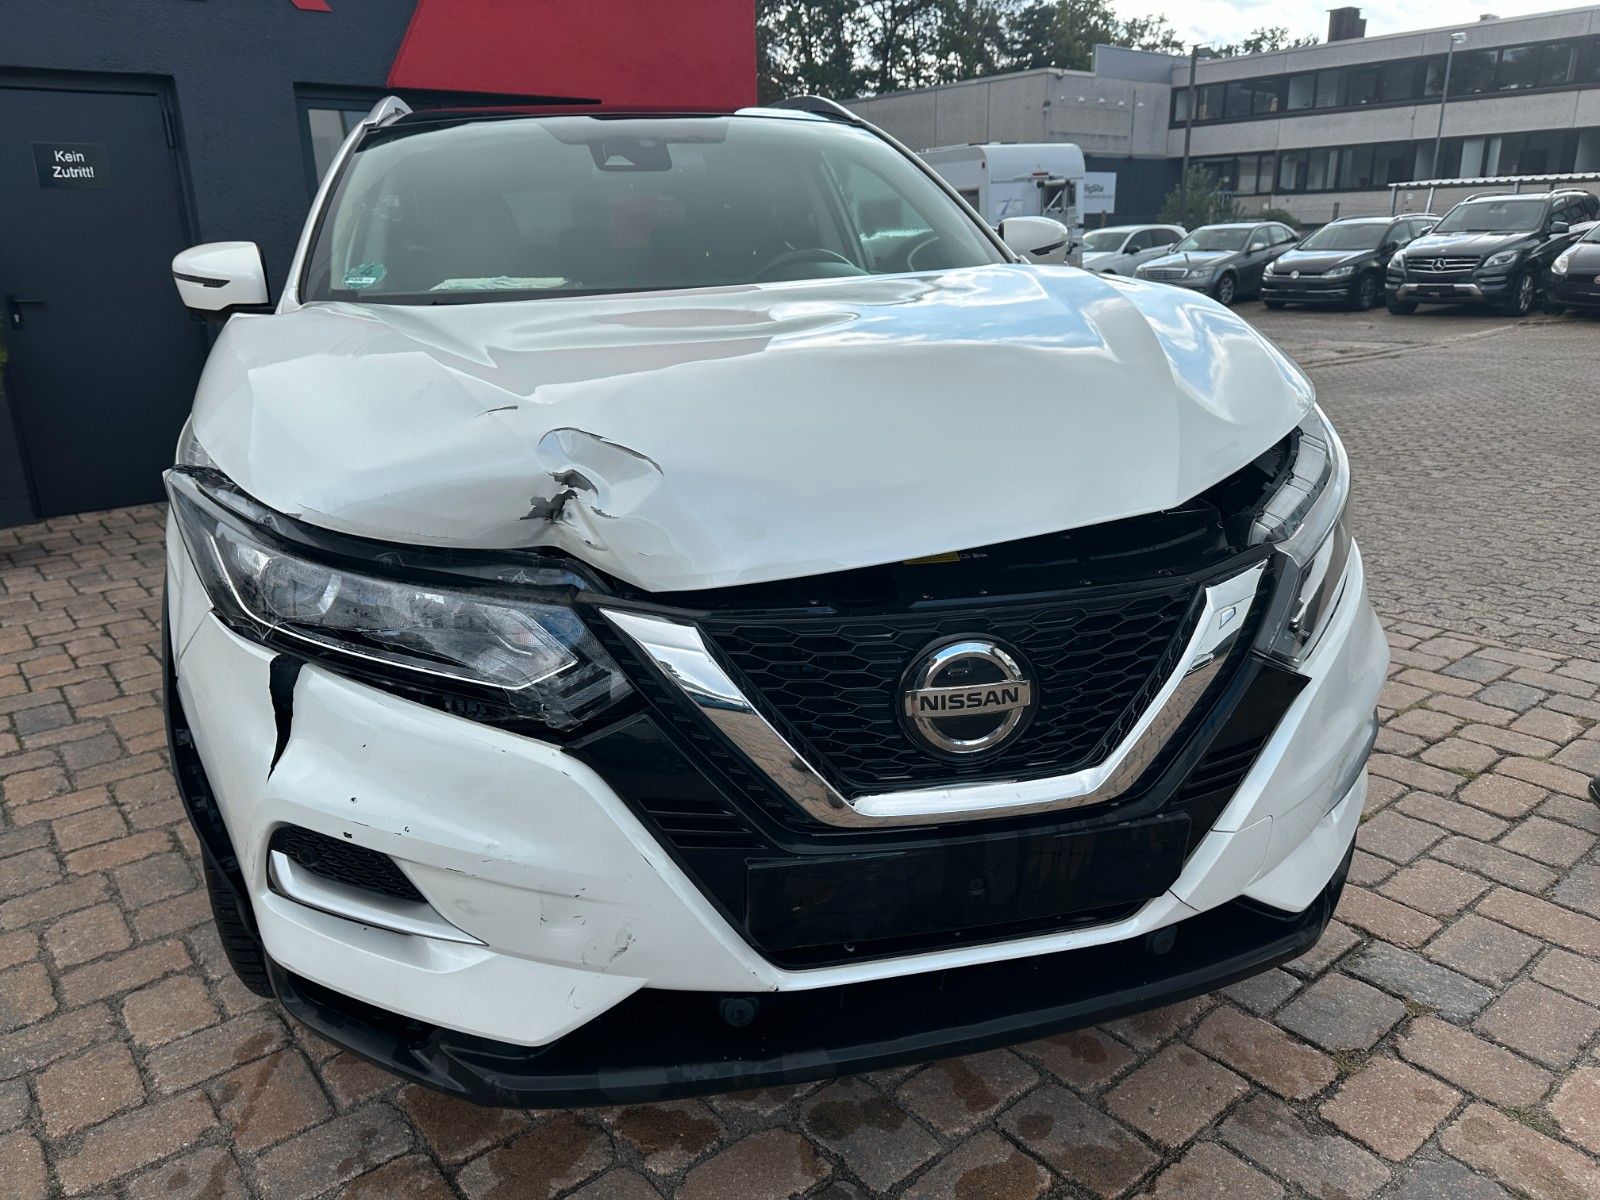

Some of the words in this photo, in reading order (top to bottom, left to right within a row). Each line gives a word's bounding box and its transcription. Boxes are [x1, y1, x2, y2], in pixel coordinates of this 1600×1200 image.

[54, 150, 85, 162] Kein
[52, 166, 95, 178] Zutritt!
[920, 687, 1019, 711] NISSAN
